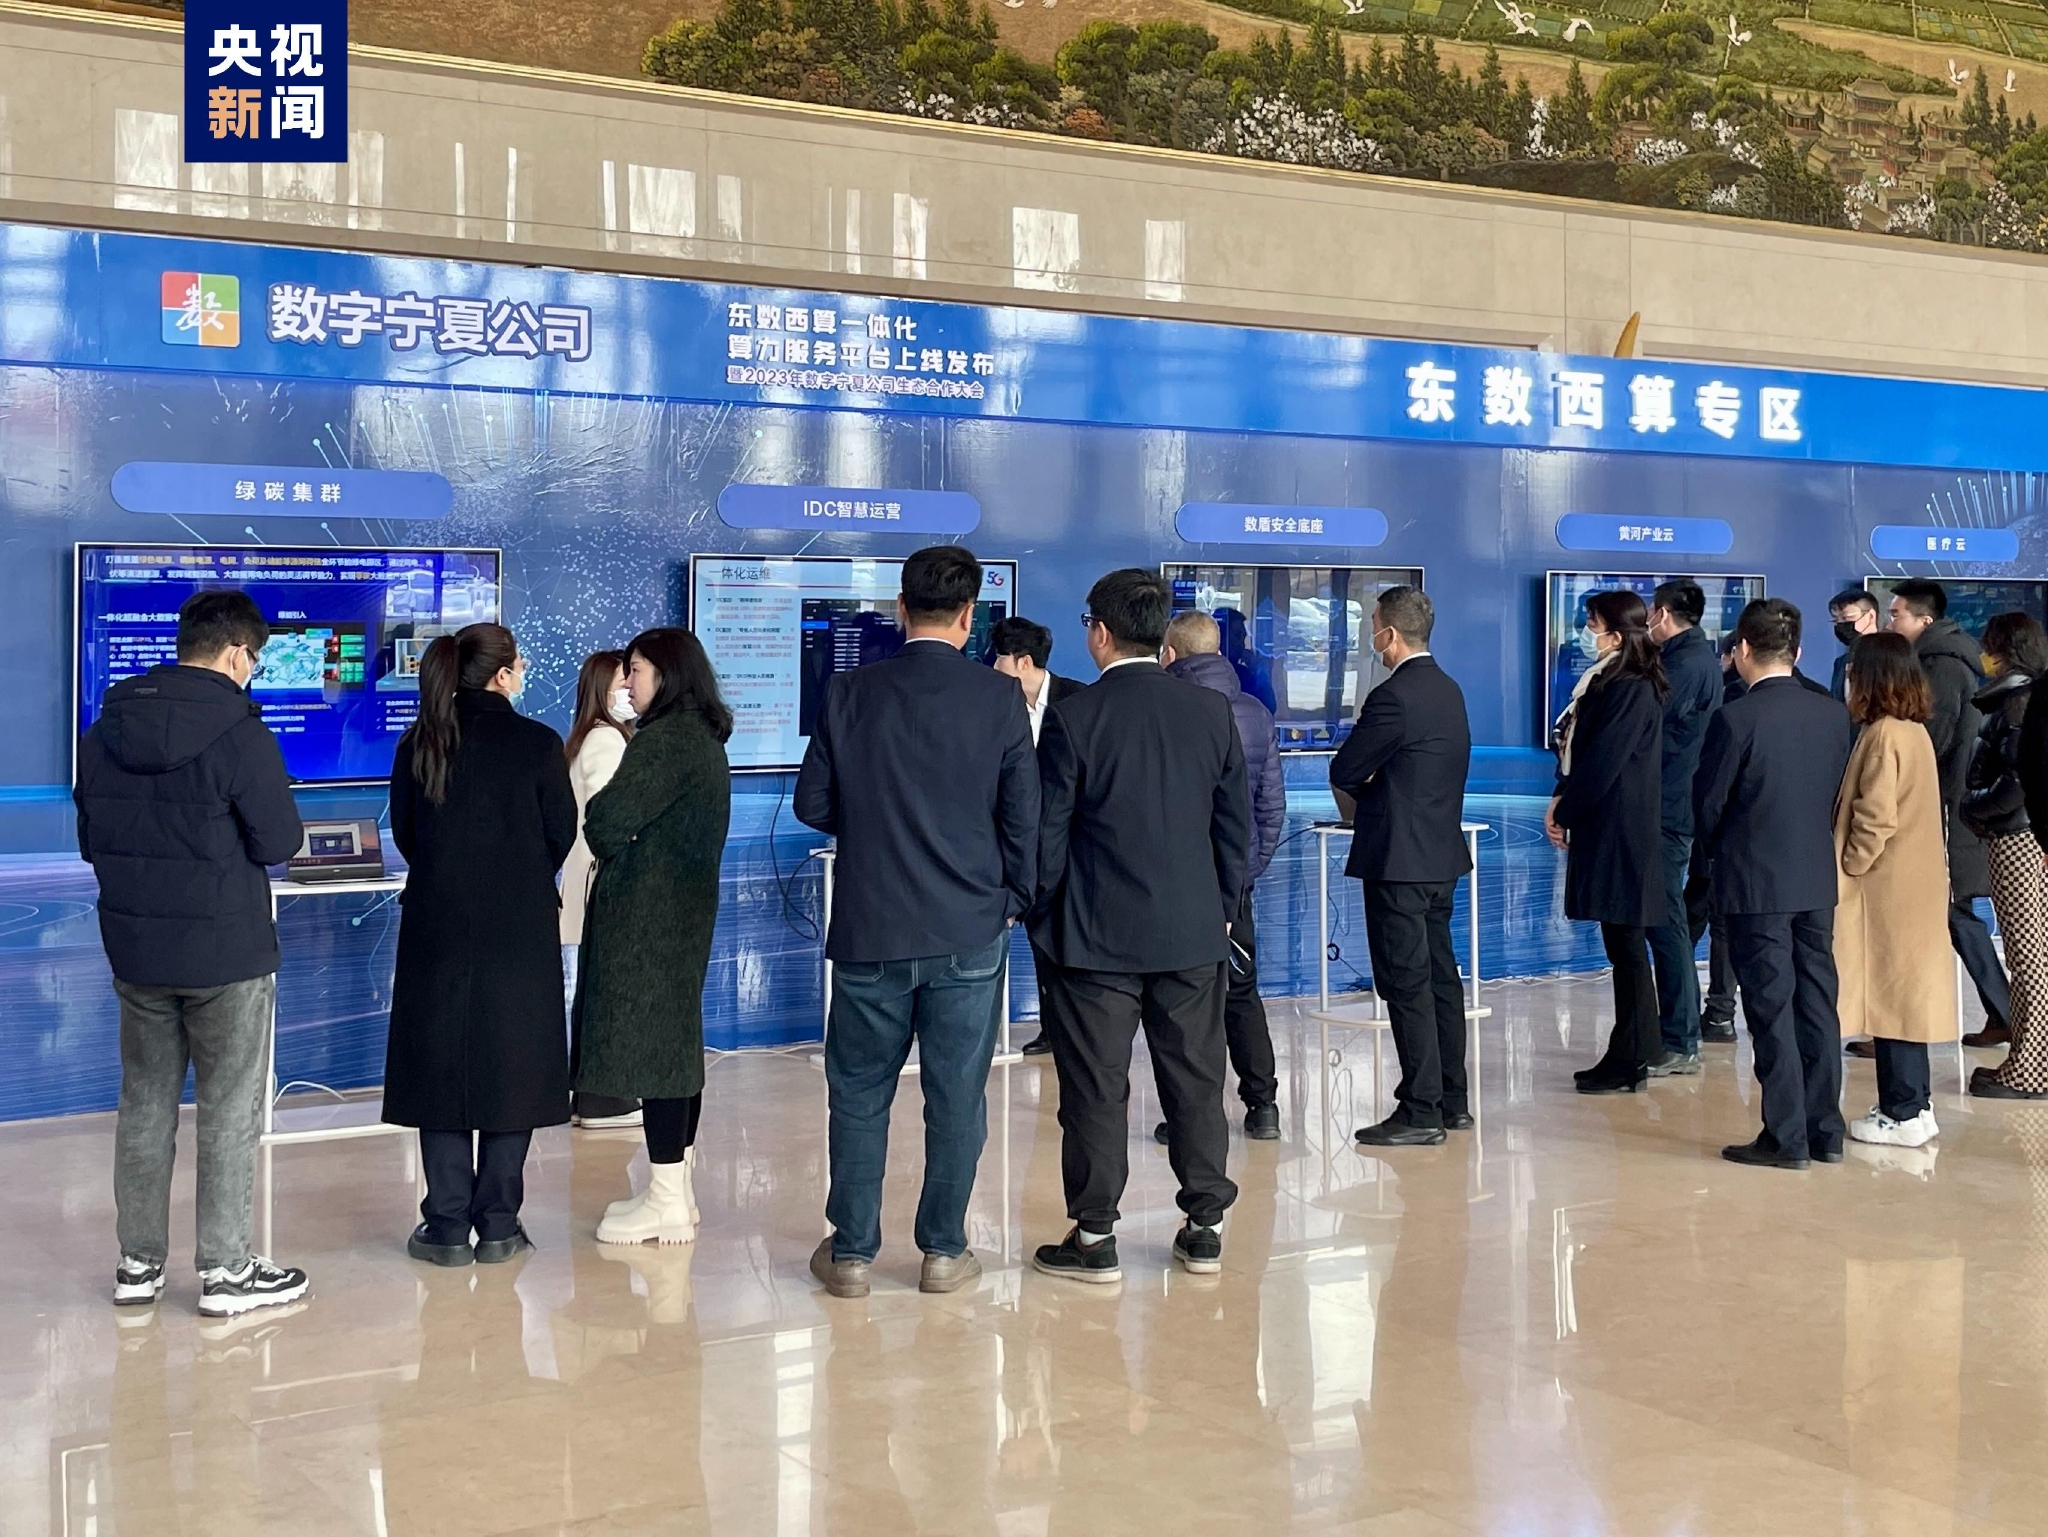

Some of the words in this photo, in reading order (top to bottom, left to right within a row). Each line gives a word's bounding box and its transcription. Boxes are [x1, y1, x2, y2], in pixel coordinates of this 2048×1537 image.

[269, 284, 592, 360] 数字宁夏公司
[727, 302, 918, 341] 东数西算一体化
[727, 334, 995, 377] 算力服务平台上线发布
[726, 367, 985, 399] 暨2023年数字宁夏公司生态合作大会
[1406, 361, 1803, 442] 东数西算专区
[234, 479, 342, 504] 绿碳集群
[803, 499, 901, 521] IDC智慧运营
[1244, 516, 1324, 535] 数盾安全底座
[1618, 525, 1675, 544] 黄河产业云
[1926, 537, 1967, 551] 医疗云
[708, 565, 772, 581] 一体化运维
[986, 571, 1005, 587] 5G
